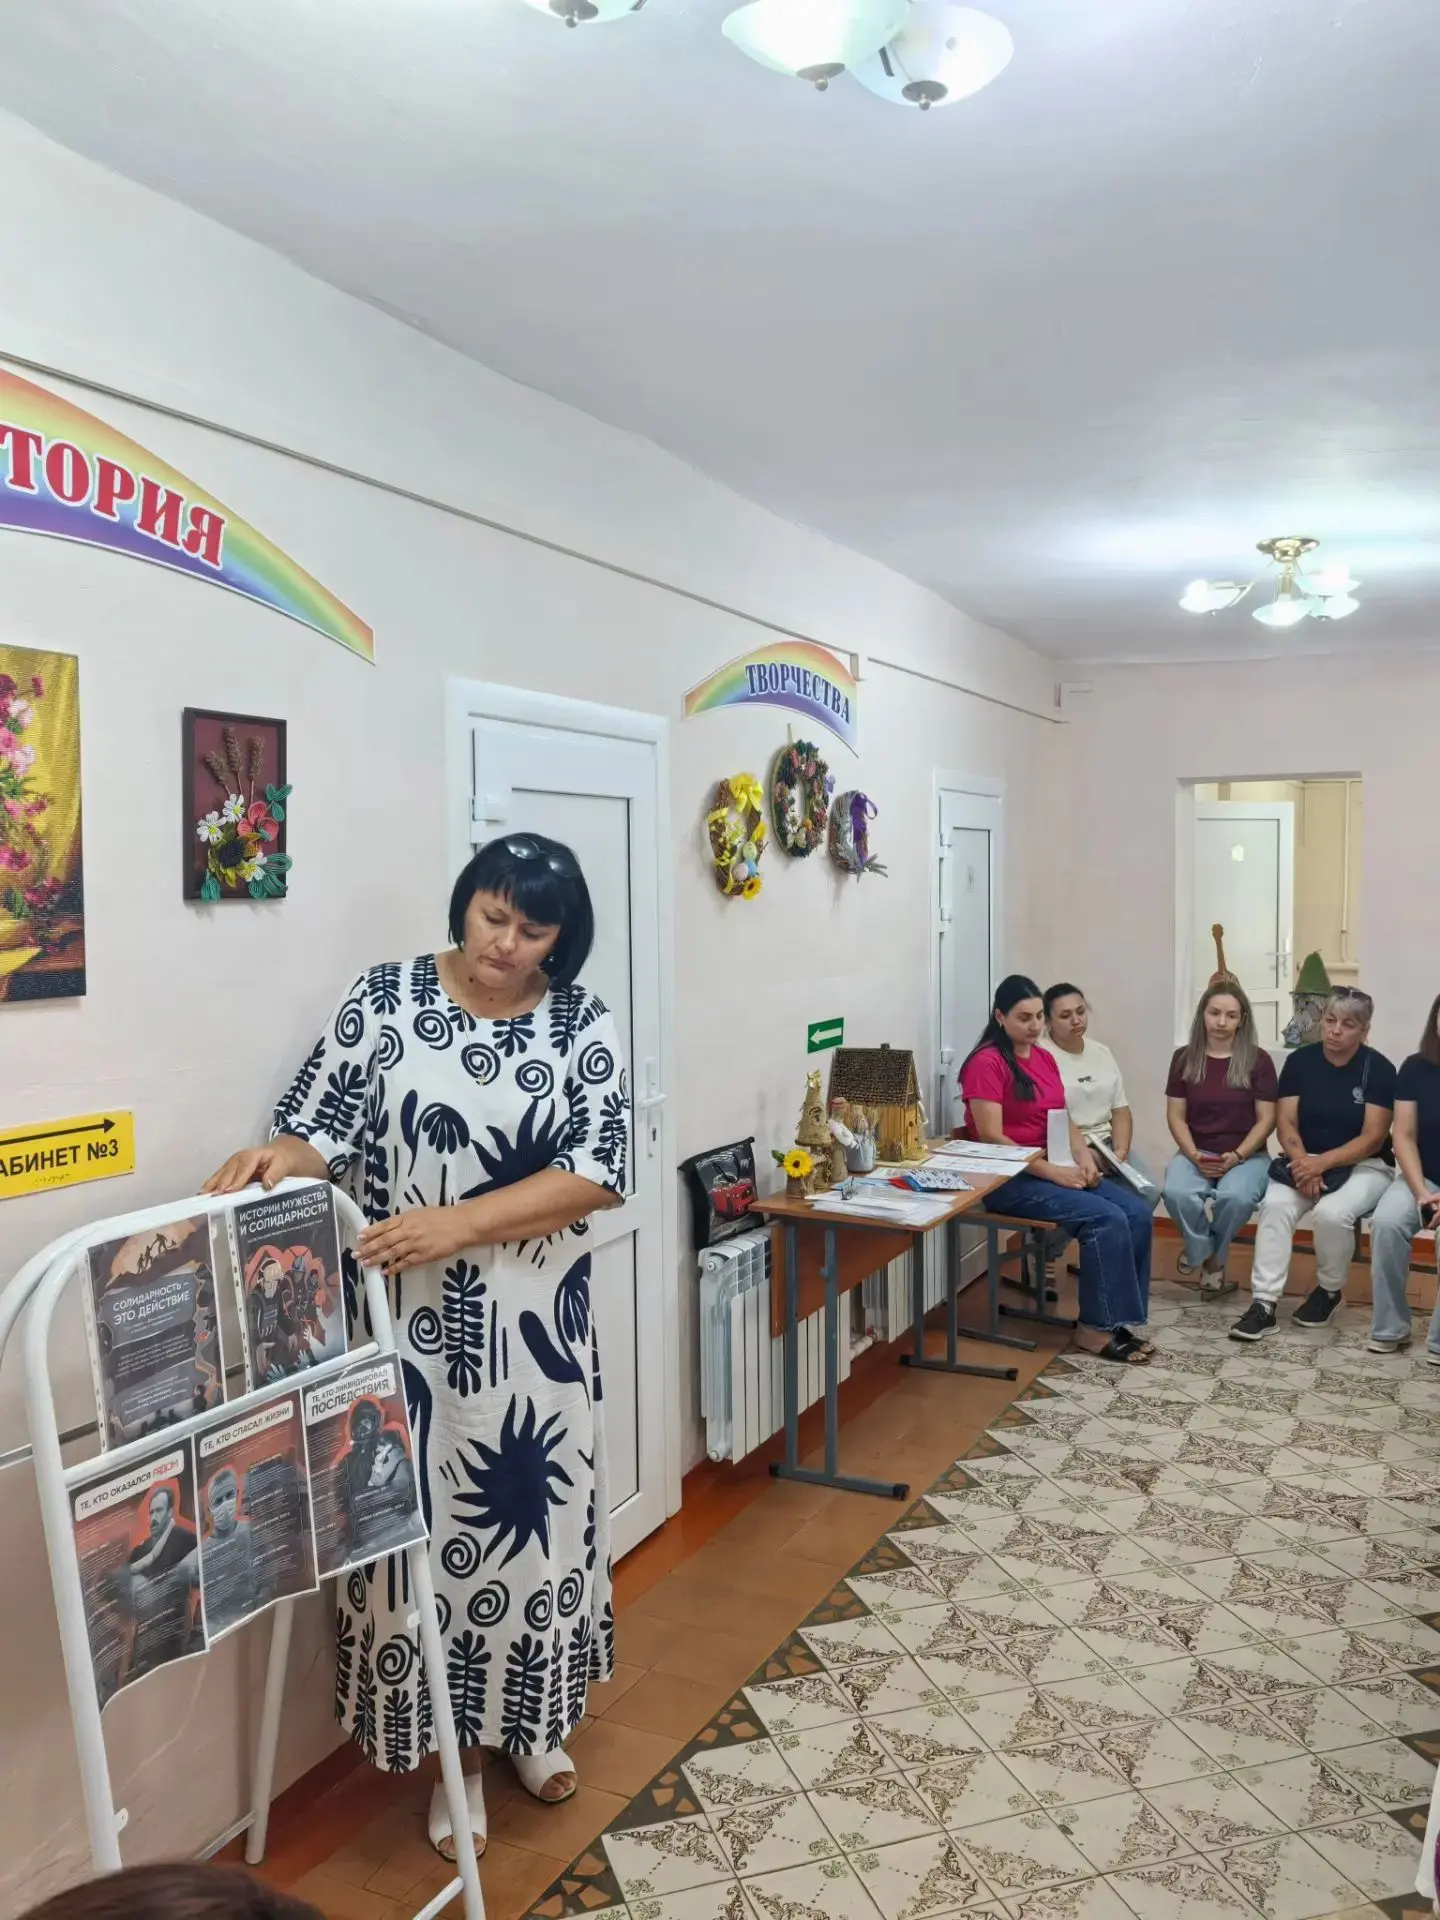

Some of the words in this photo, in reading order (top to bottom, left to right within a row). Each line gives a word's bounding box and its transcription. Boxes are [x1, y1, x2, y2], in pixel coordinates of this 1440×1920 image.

[0, 423, 226, 567] ТОРИЯ
[745, 663, 850, 724] ТВОРЧЕСТВА
[87, 1138, 119, 1161] №3
[239, 1202, 281, 1222] ИСТОРИИ
[282, 1190, 328, 1210] МУЖЕСТВА
[240, 1225, 248, 1237] И
[248, 1202, 329, 1233] СОЛИДАРНОСТИ
[113, 1282, 182, 1311] СОЛИДАРНОСТЬ
[114, 1310, 136, 1325] ЭТО
[138, 1290, 190, 1319] ДЕЙСТВИЕ
[311, 1379, 390, 1416] ПОСЛЕДСТВИЯ
[321, 1390, 335, 1400] КТО
[203, 1440, 215, 1451] ТЕ,
[216, 1432, 231, 1445] КТО
[232, 1418, 263, 1437] СПАСАЛ
[264, 1406, 290, 1422] ЖИЗНИ
[80, 1501, 92, 1511] ТЕ,
[93, 1492, 109, 1505] КТО
[110, 1472, 151, 1496] ОКАЗАЛСЯ
